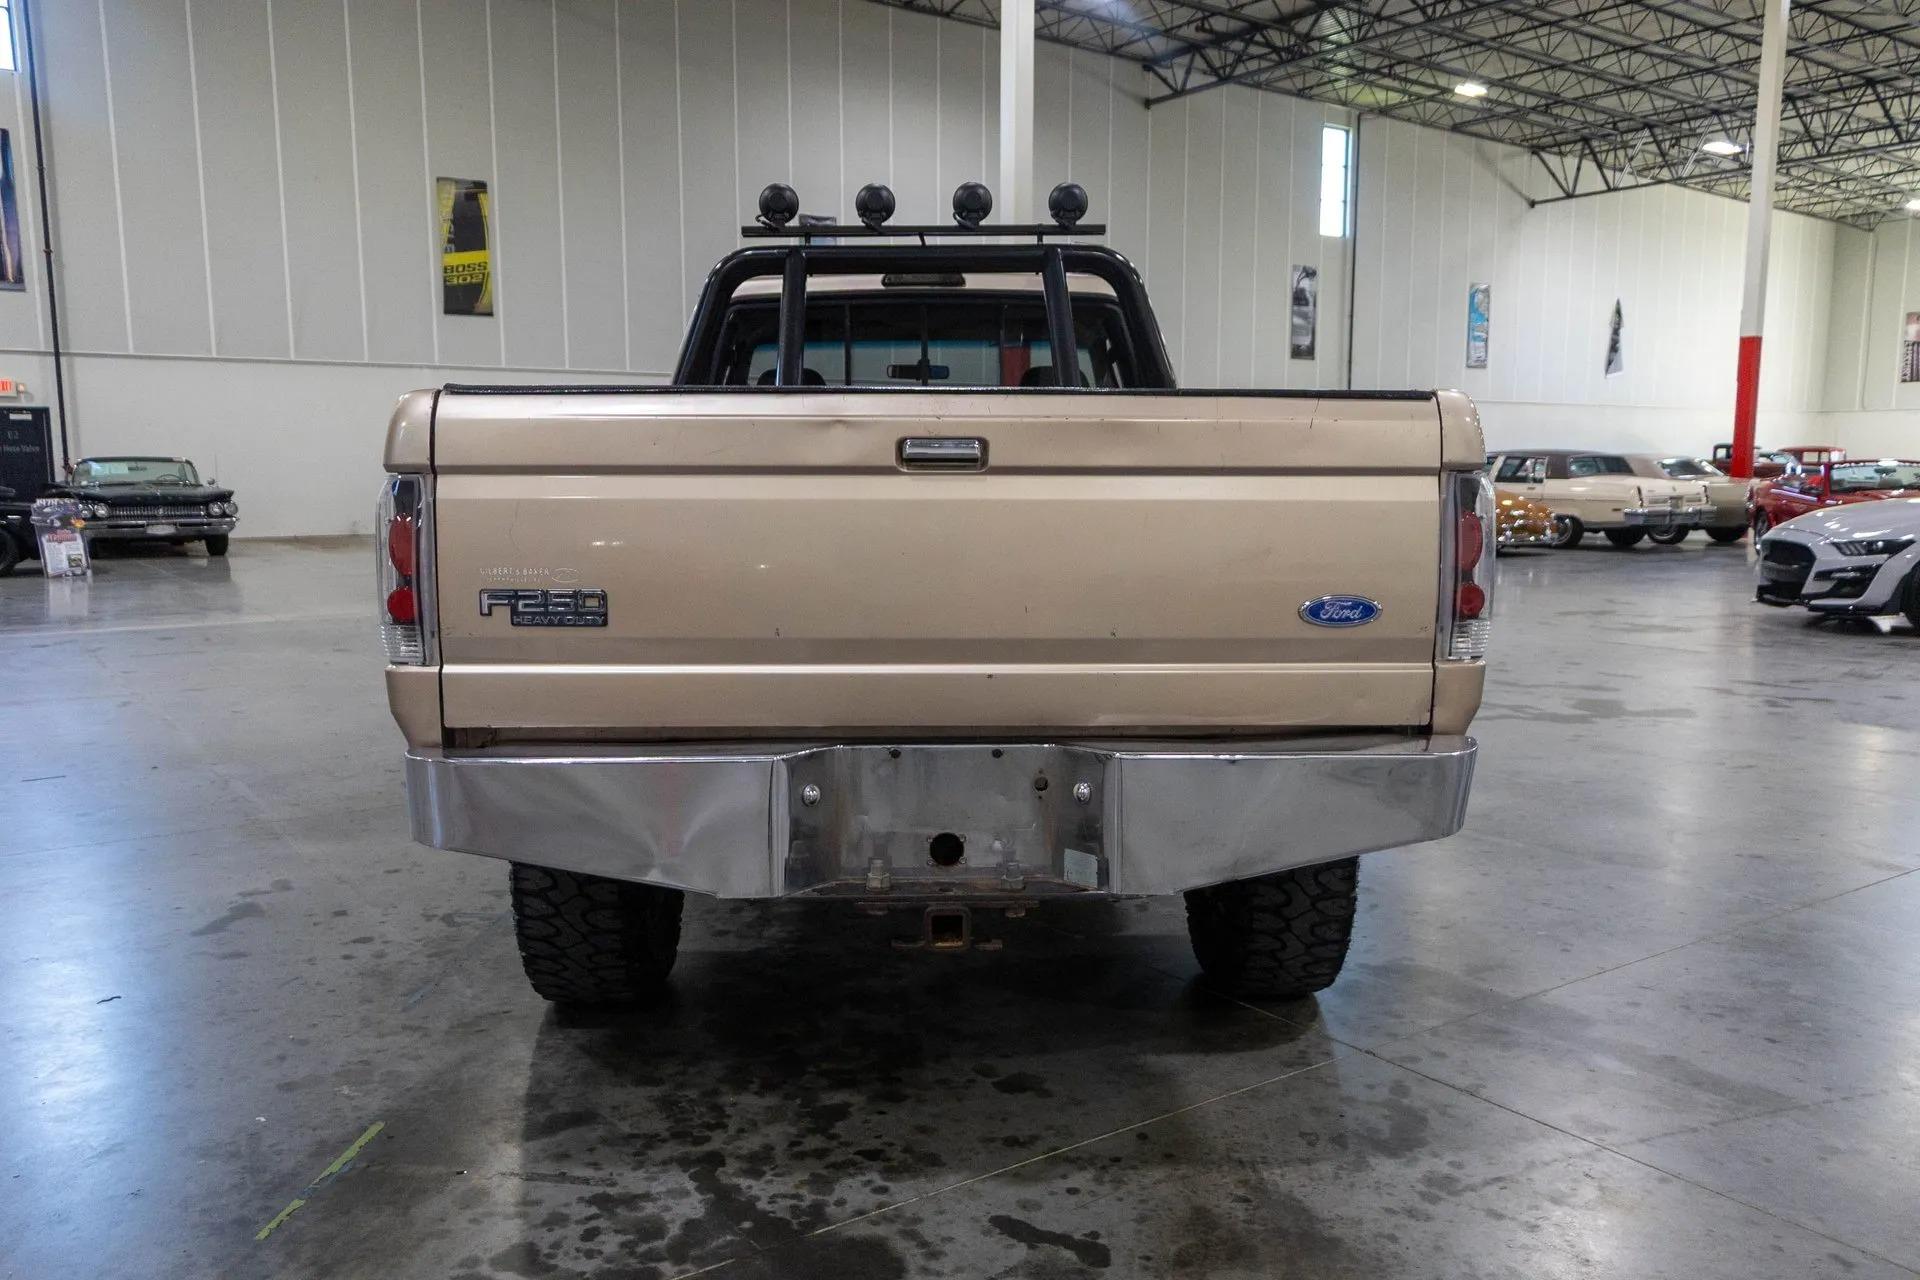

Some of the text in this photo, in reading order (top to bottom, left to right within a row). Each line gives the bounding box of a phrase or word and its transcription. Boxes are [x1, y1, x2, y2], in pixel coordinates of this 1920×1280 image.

[444, 261, 488, 274] BOSS
[446, 273, 483, 286] 302
[1320, 601, 1363, 619] Ford
[513, 616, 605, 625] HEAVY DUTY
